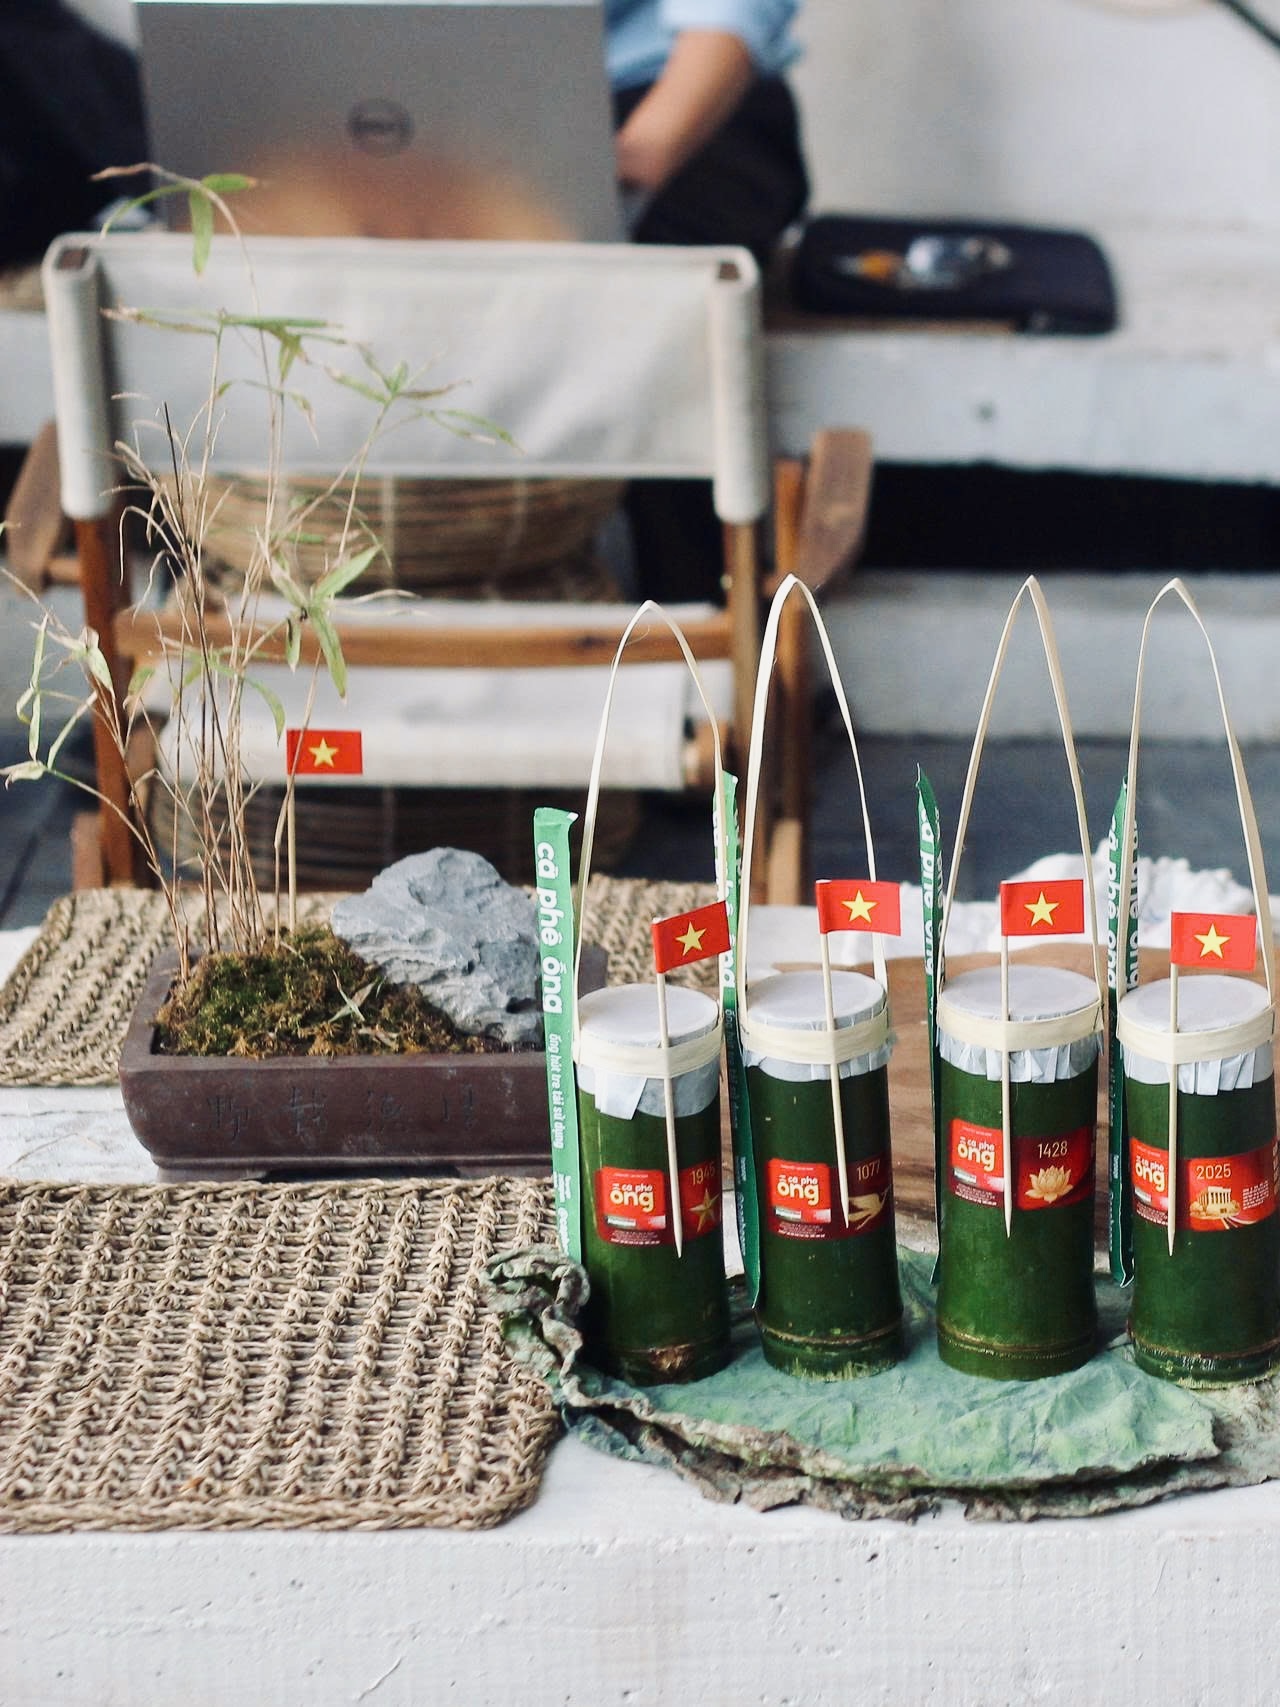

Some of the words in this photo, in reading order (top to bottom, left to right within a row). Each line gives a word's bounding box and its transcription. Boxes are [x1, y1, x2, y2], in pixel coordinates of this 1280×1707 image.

[537, 886, 564, 946] phê
[1038, 1141, 1068, 1159] 1428
[857, 1159, 881, 1180] 1077
[1196, 1164, 1232, 1180] 2025
